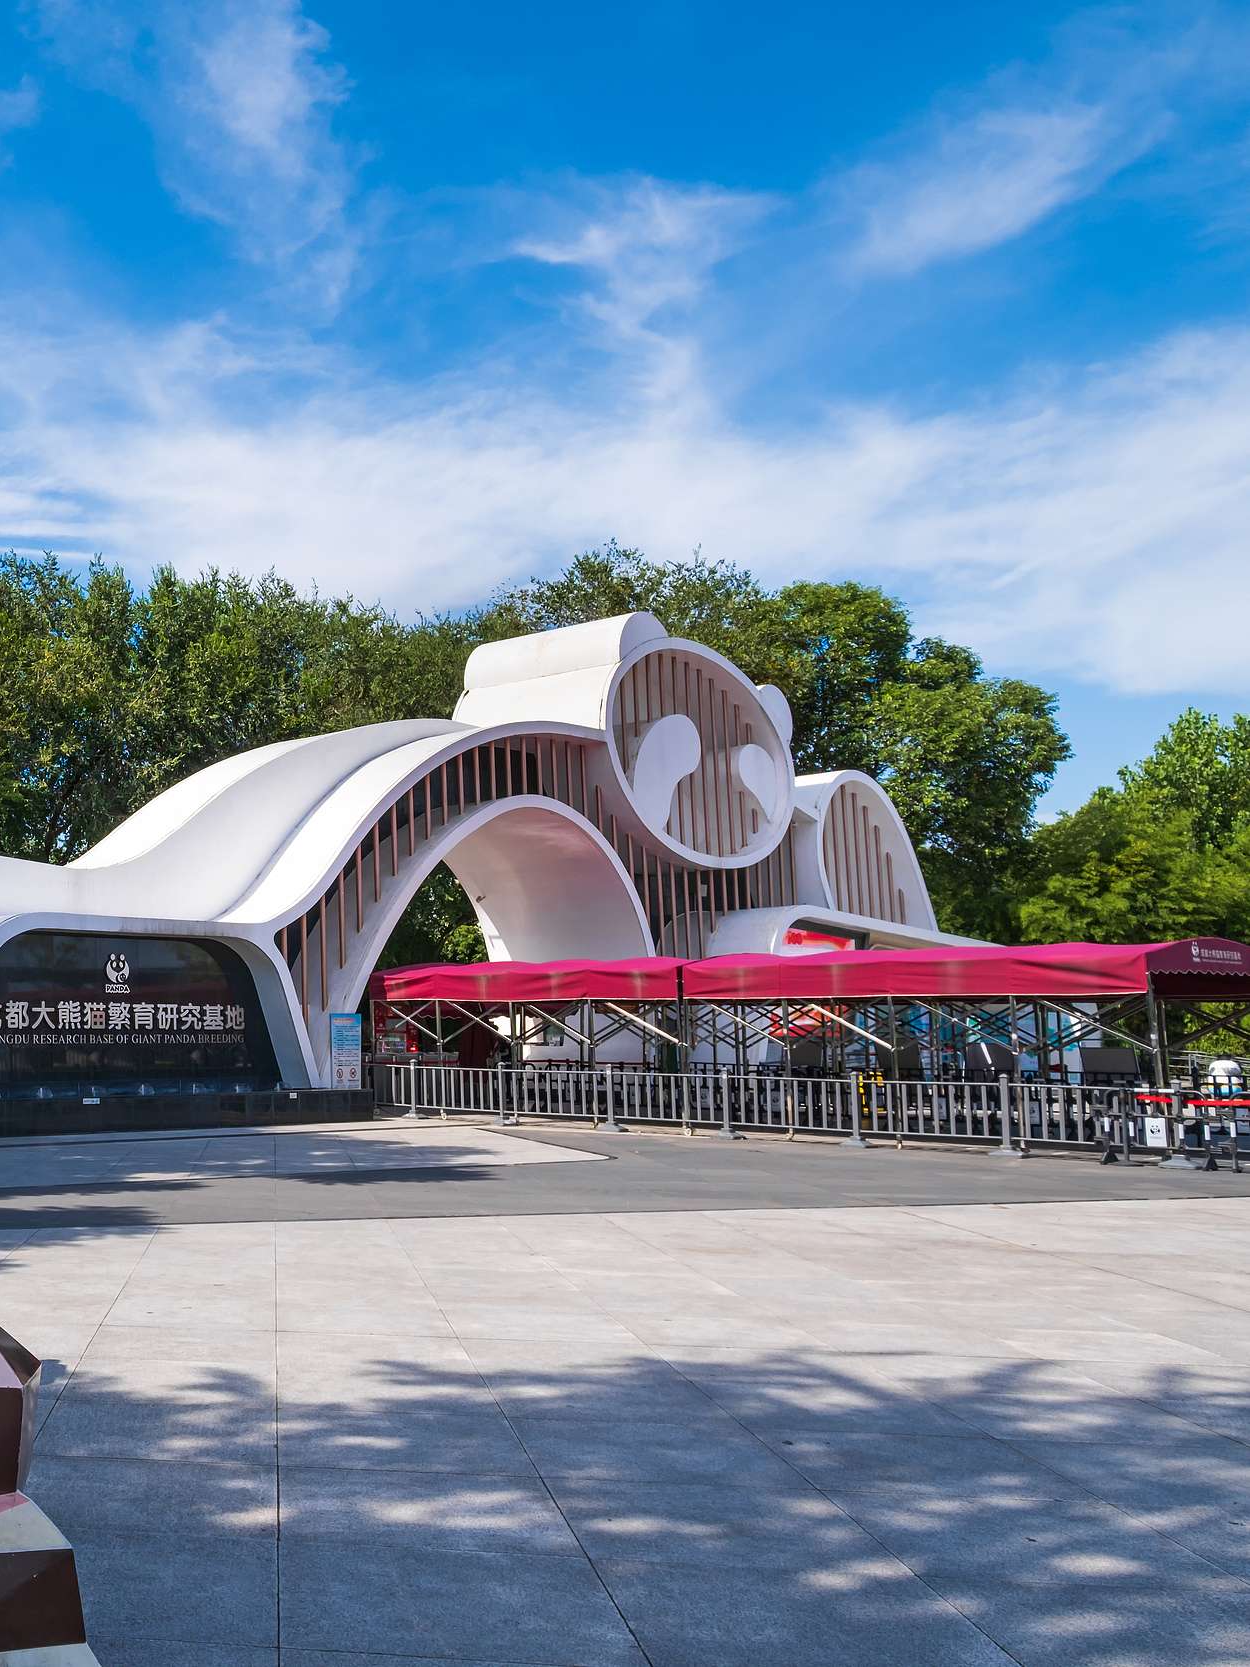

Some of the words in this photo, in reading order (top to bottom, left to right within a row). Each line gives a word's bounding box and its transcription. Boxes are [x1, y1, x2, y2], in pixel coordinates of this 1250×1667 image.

[105, 984, 131, 993] PANDA
[33, 1034, 86, 1044] RESEARCH
[90, 1034, 114, 1044] BASE
[116, 1034, 129, 1044] OF
[132, 1034, 162, 1044] GIANT
[165, 1034, 196, 1044] PANDA
[198, 1034, 245, 1044] BREEDING
